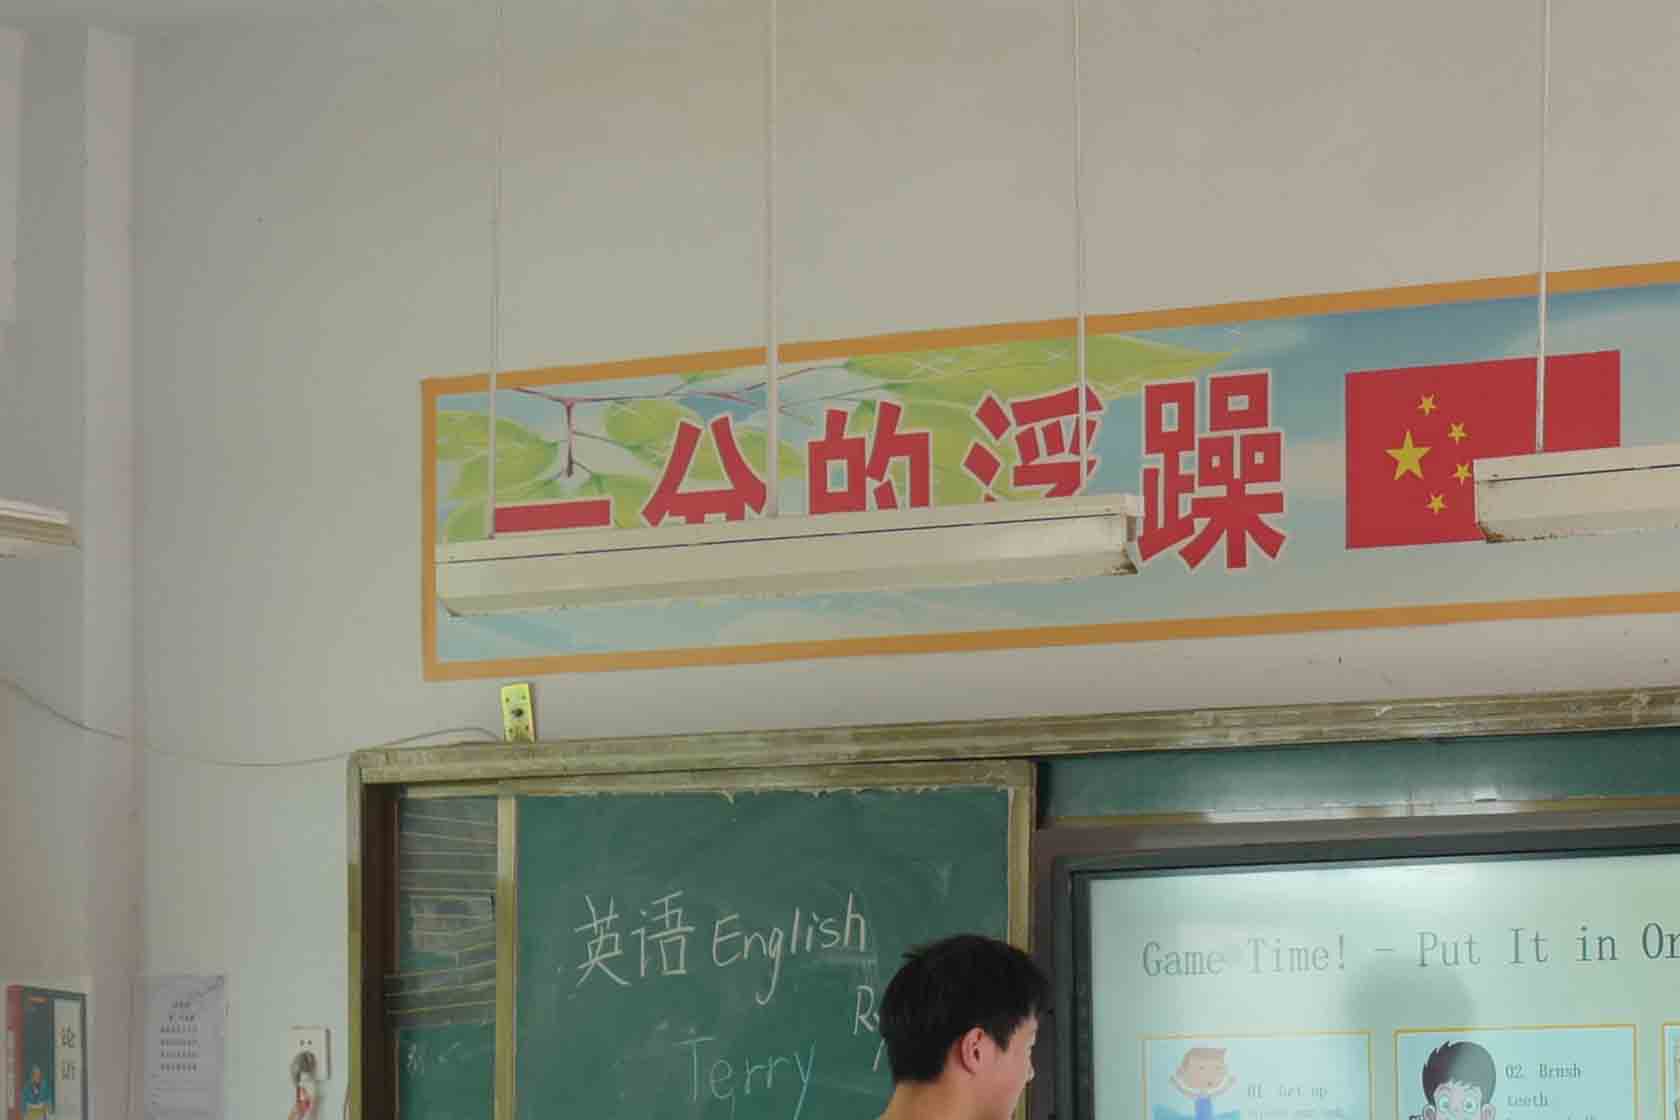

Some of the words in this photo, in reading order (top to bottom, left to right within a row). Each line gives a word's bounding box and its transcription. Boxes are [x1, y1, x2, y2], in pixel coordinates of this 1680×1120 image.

[573, 890, 697, 988] 英语
[711, 892, 869, 1005] English
[1142, 940, 1224, 977] Game
[1247, 934, 1346, 972] Time!
[1418, 930, 1481, 968] Put
[1509, 927, 1549, 965] It
[1576, 926, 1618, 962] in
